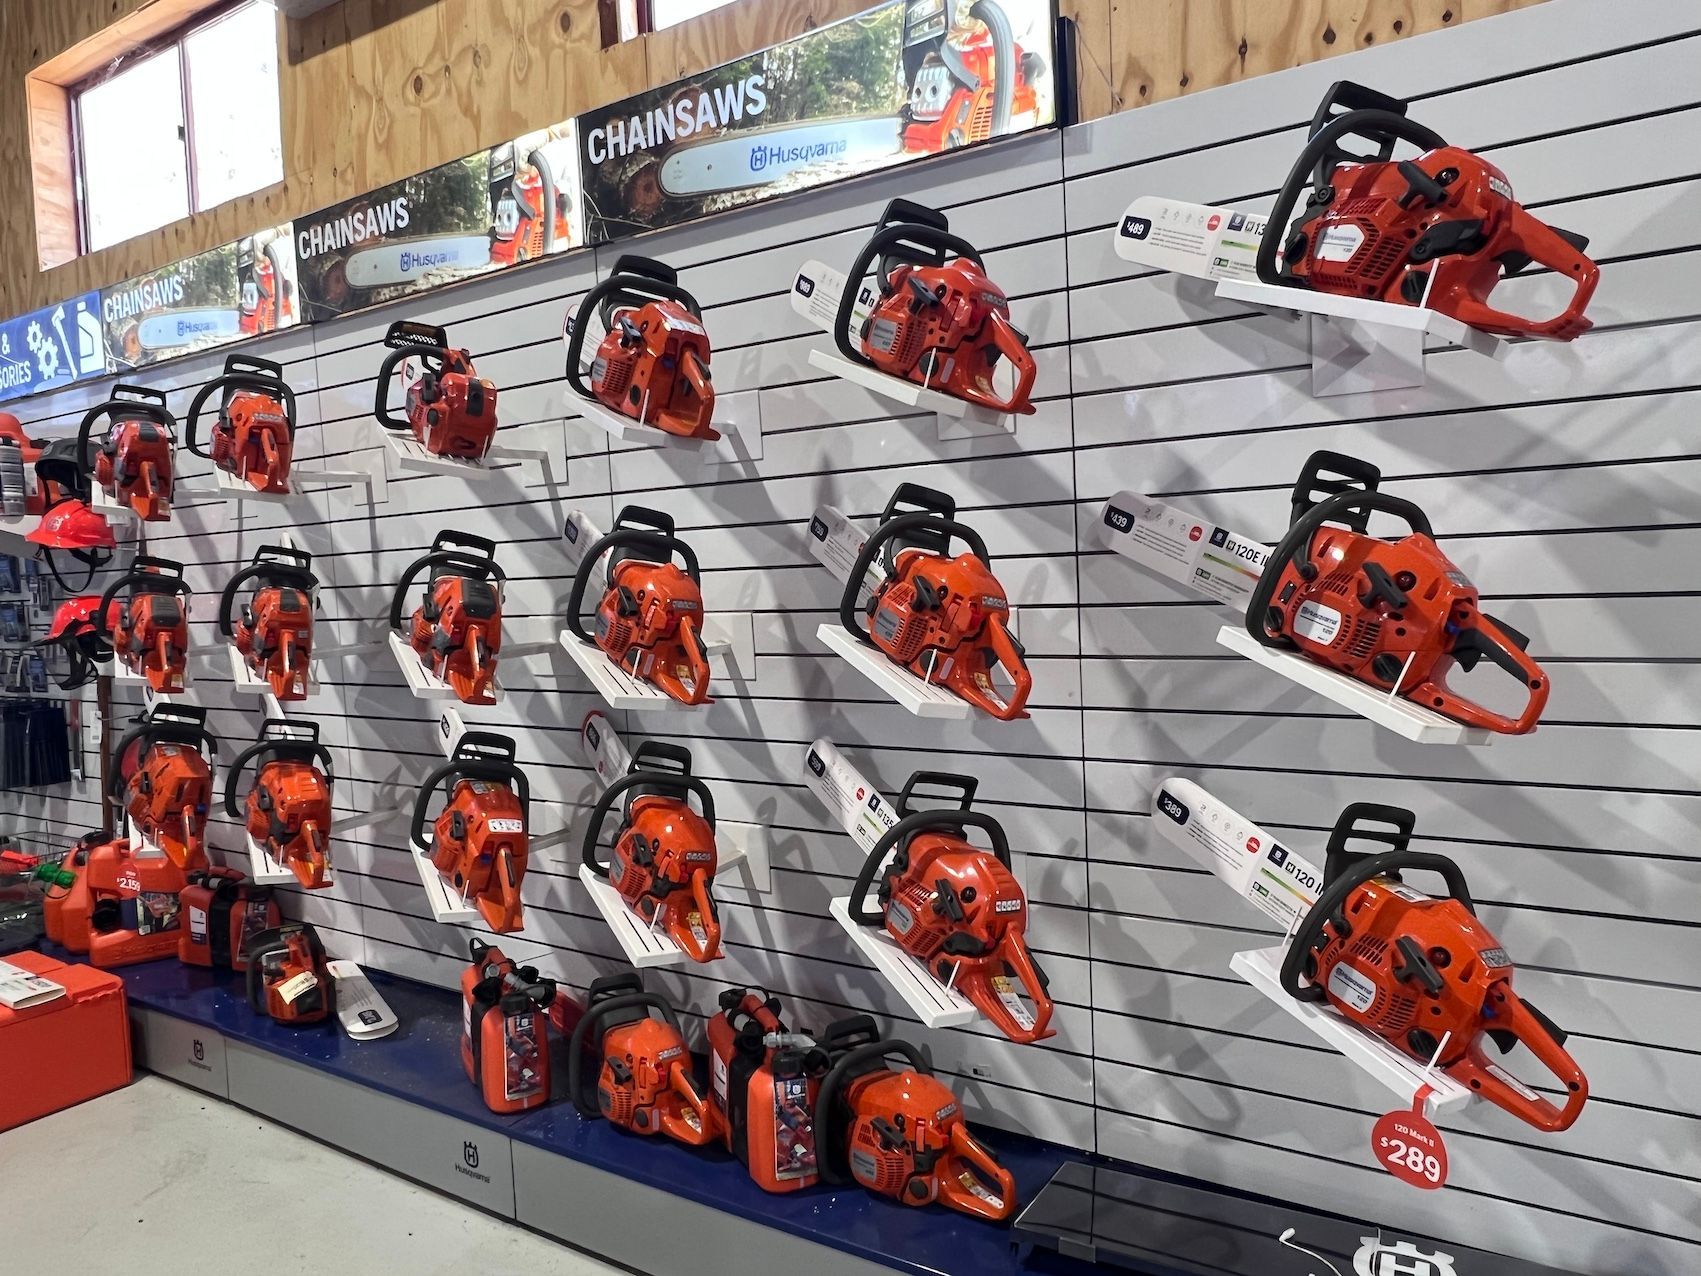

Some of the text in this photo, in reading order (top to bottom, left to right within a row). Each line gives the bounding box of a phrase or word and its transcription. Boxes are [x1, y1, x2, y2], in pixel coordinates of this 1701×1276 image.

[588, 75, 767, 165] CHAINSAWS
[769, 140, 847, 166] Husqvarna
[298, 197, 410, 260] CHAINSAWS
[1127, 220, 1144, 236] $489
[103, 275, 184, 323] CHAINSAWS
[1, 333, 10, 355] &
[1111, 511, 1128, 528] $439
[1235, 543, 1261, 564] 120E
[1164, 797, 1182, 818] $389
[1294, 868, 1315, 889] 120
[1394, 1123, 1409, 1135] 120
[1409, 1128, 1428, 1144] Mark
[1380, 1136, 1441, 1183] $289
[455, 1162, 491, 1184] Husqvarna
